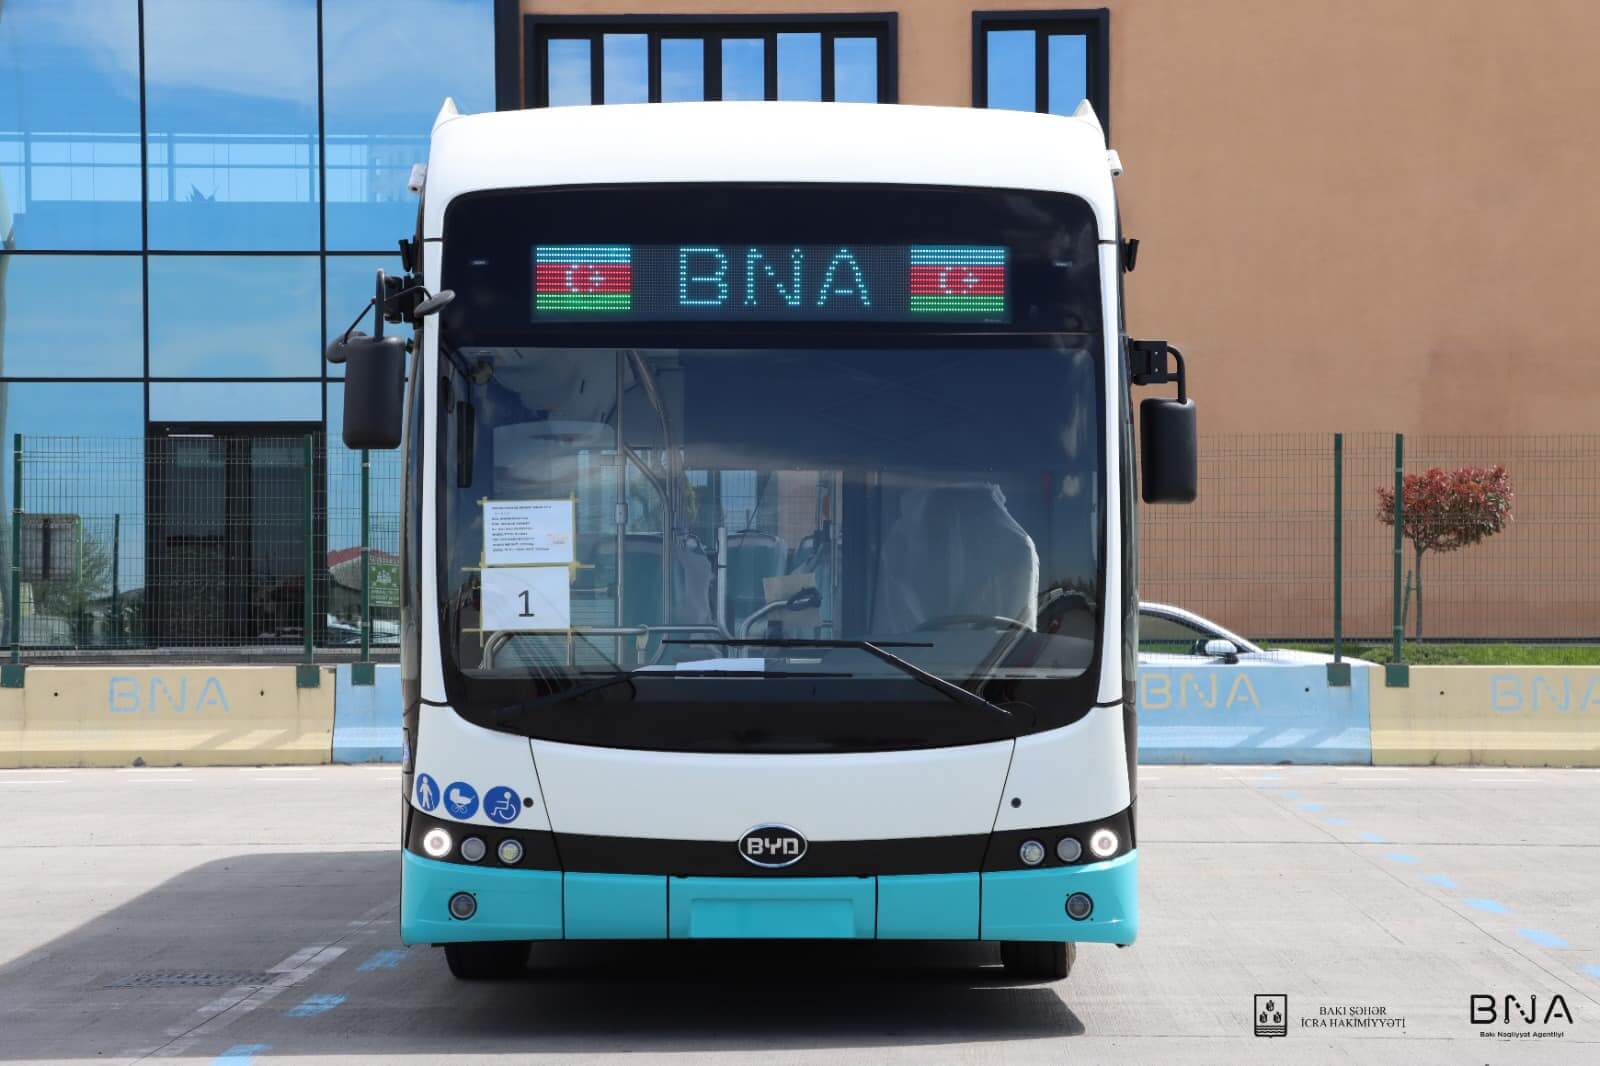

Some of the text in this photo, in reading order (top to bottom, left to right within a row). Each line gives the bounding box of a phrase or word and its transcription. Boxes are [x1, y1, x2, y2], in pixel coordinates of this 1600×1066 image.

[680, 248, 871, 304] BNA
[518, 590, 535, 617] 1
[108, 677, 230, 713] BNA
[1141, 672, 1262, 709] BNA
[747, 838, 799, 855] BYD
